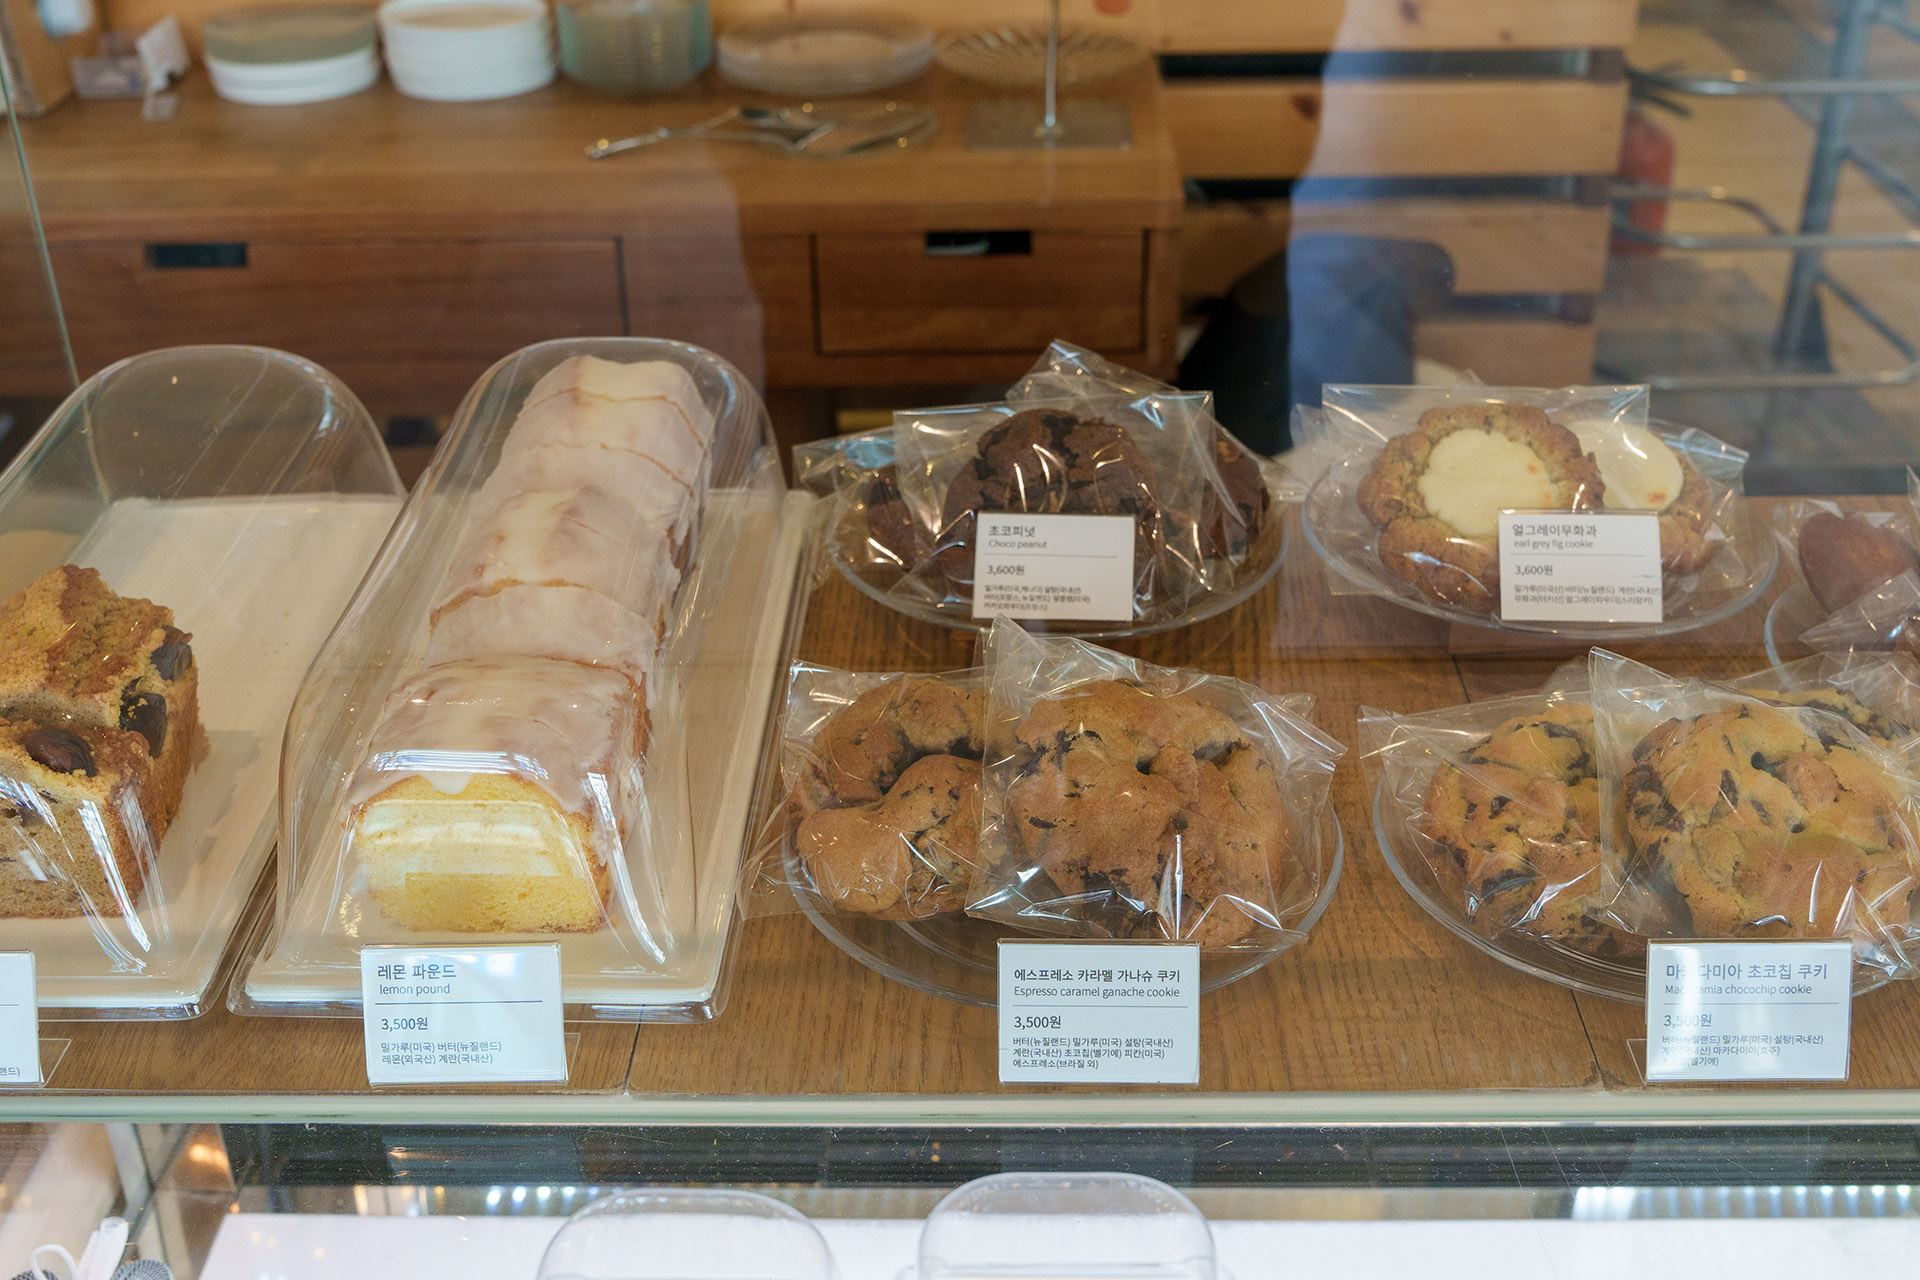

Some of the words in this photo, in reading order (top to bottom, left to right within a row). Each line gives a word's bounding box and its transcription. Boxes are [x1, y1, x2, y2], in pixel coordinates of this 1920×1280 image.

[988, 525, 1036, 538] 초코피넛
[1512, 524, 1597, 537] 얼그레이무화과
[988, 539, 1016, 549] Choco
[1017, 540, 1047, 550] peanut
[1513, 540, 1530, 548] earl
[1532, 540, 1550, 549] grey
[1552, 540, 1564, 549] fig
[1564, 540, 1594, 548] cookie
[986, 565, 1025, 576] 3,600원
[1514, 565, 1553, 576] 3,600원
[377, 964, 407, 980] 레몬
[411, 963, 457, 980] 파운드
[1014, 969, 1074, 982] 에스프레소
[1078, 969, 1113, 983] 카라멜
[1117, 969, 1153, 983] 가나슈
[1157, 970, 1180, 983] 쿠키
[1747, 963, 1792, 980] 초코칩
[1798, 963, 1828, 980] 쿠키
[379, 984, 413, 995] lemon
[416, 983, 451, 996] pound
[1014, 986, 1058, 998] Espresso
[1060, 986, 1100, 997] caramel
[1102, 987, 1145, 999] ganache
[1147, 987, 1180, 997] cookie
[1725, 984, 1776, 996] chocochip
[1778, 984, 1812, 994] cookie
[381, 1016, 429, 1032] 3,500원
[1014, 1016, 1061, 1030] 3,500원
[1663, 1013, 1712, 1028] 3,500원
[1013, 1037, 1071, 1047] 버터(뉴질랜드)
[1072, 1037, 1123, 1047] 밀가루(미국)
[1124, 1037, 1174, 1048] 설탕(국내산)
[1722, 1035, 1772, 1045] 밀가루(미국)
[1774, 1035, 1824, 1045] 설탕(국내산)
[380, 1041, 435, 1054] 밀가루(미국)
[437, 1041, 502, 1053] 버터(뉴질랜드)
[1013, 1048, 1062, 1058] 계란(국내산)
[1064, 1048, 1122, 1059] 초코칩(벨기에)
[1124, 1049, 1165, 1059] 피칸(미국)
[1713, 1046, 1780, 1056] 마카다미아(호주)
[381, 1054, 436, 1065] 레몬(외국산)
[438, 1053, 493, 1065] 계란(국내산)
